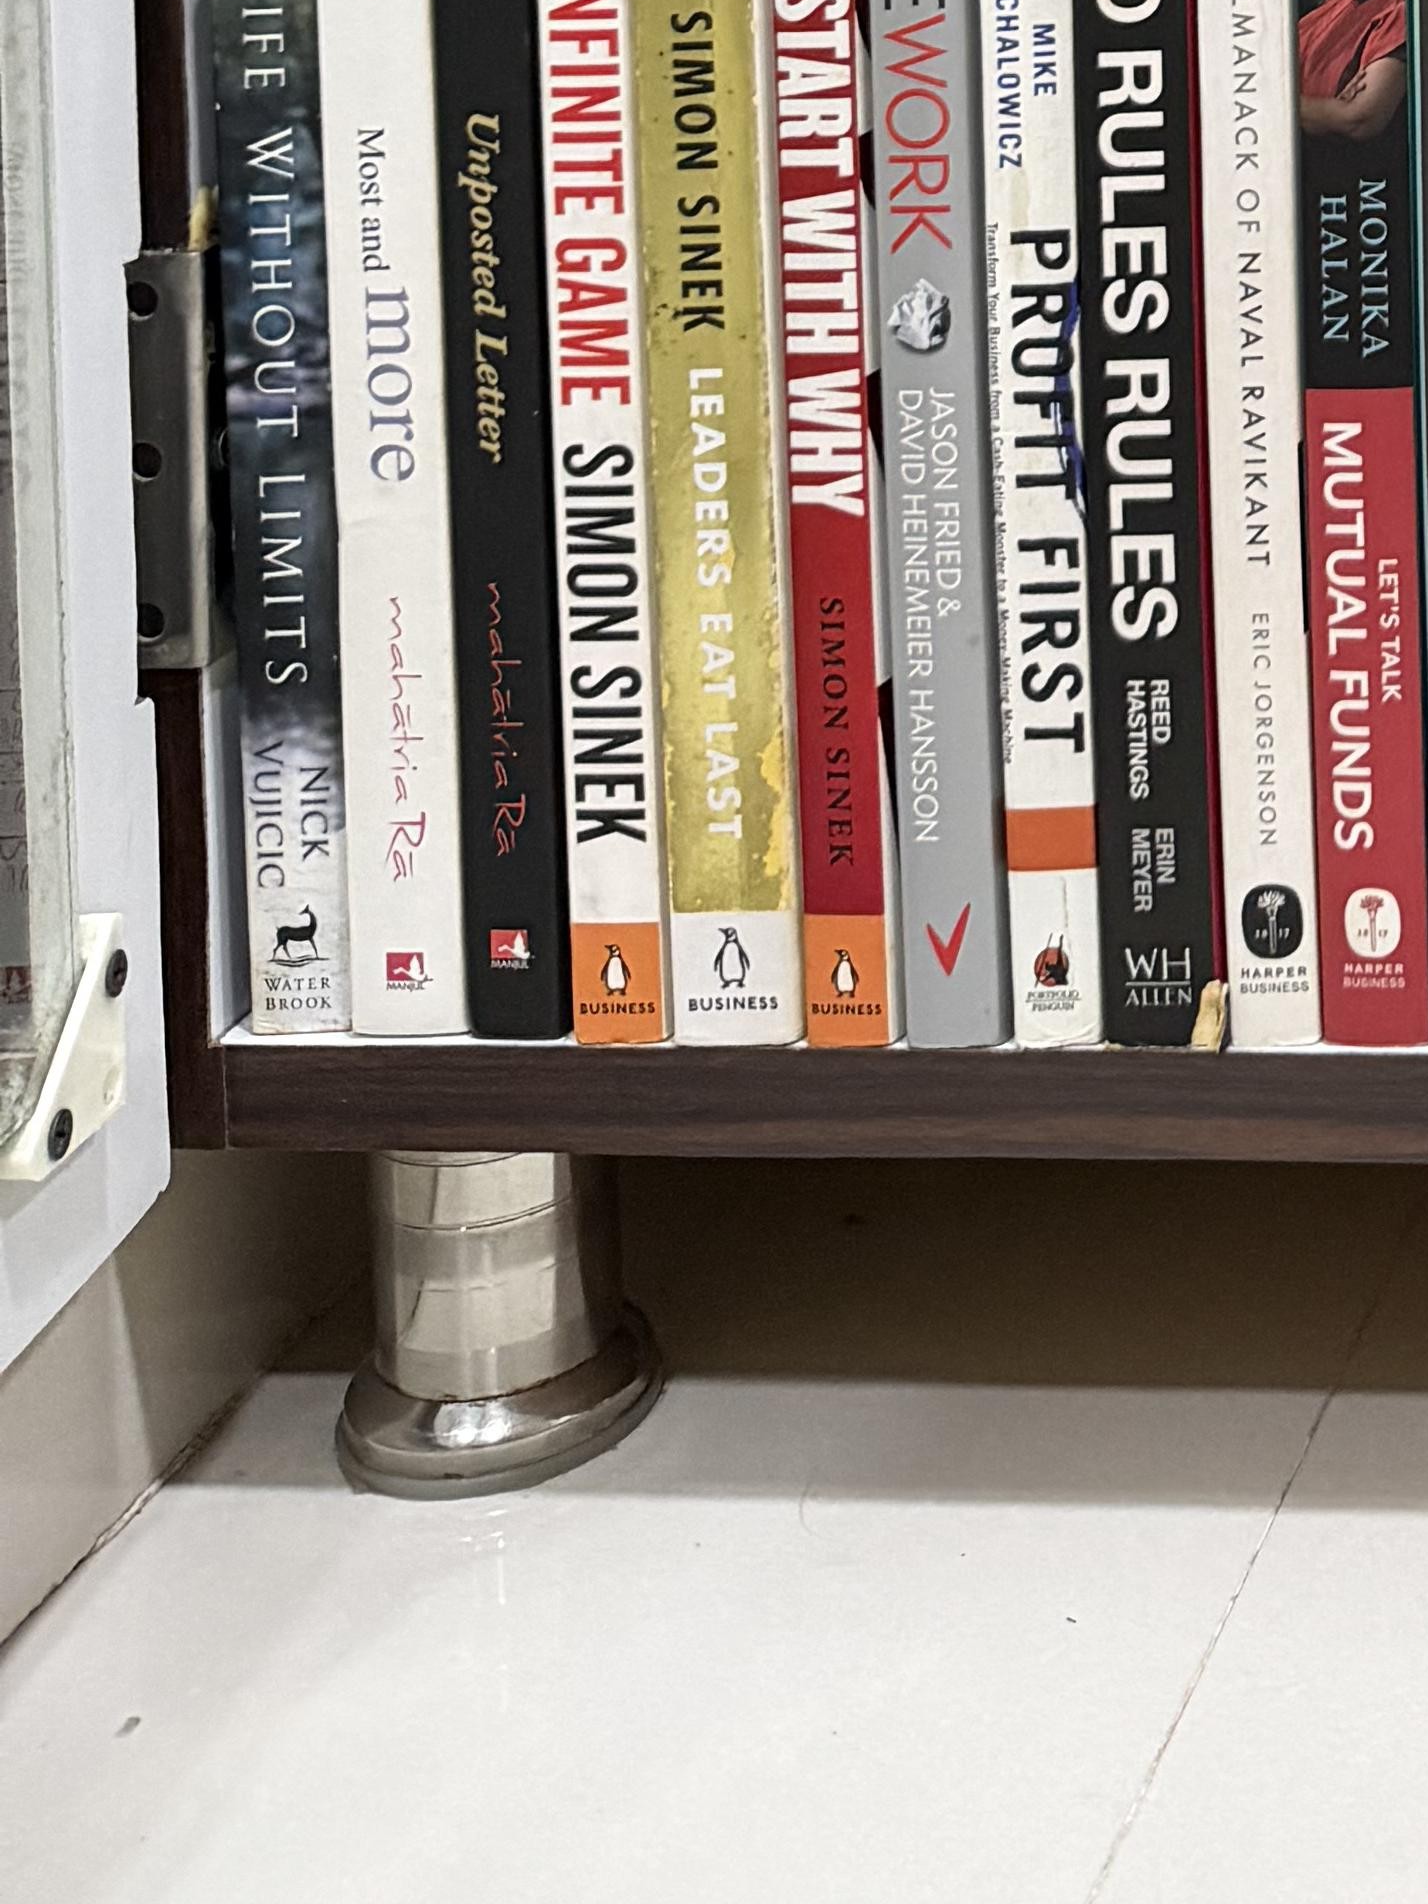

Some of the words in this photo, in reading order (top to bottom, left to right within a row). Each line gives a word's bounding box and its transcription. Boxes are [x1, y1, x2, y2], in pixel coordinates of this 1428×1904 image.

[242, 127, 297, 442] WITHOUT
[1094, 47, 1170, 341] RULES
[257, 473, 308, 691] LIMITS
[1100, 360, 1178, 644] RULES
[264, 976, 332, 996] WATER
[265, 994, 331, 1012] BROOK
[687, 992, 780, 1014] BUSINESS
